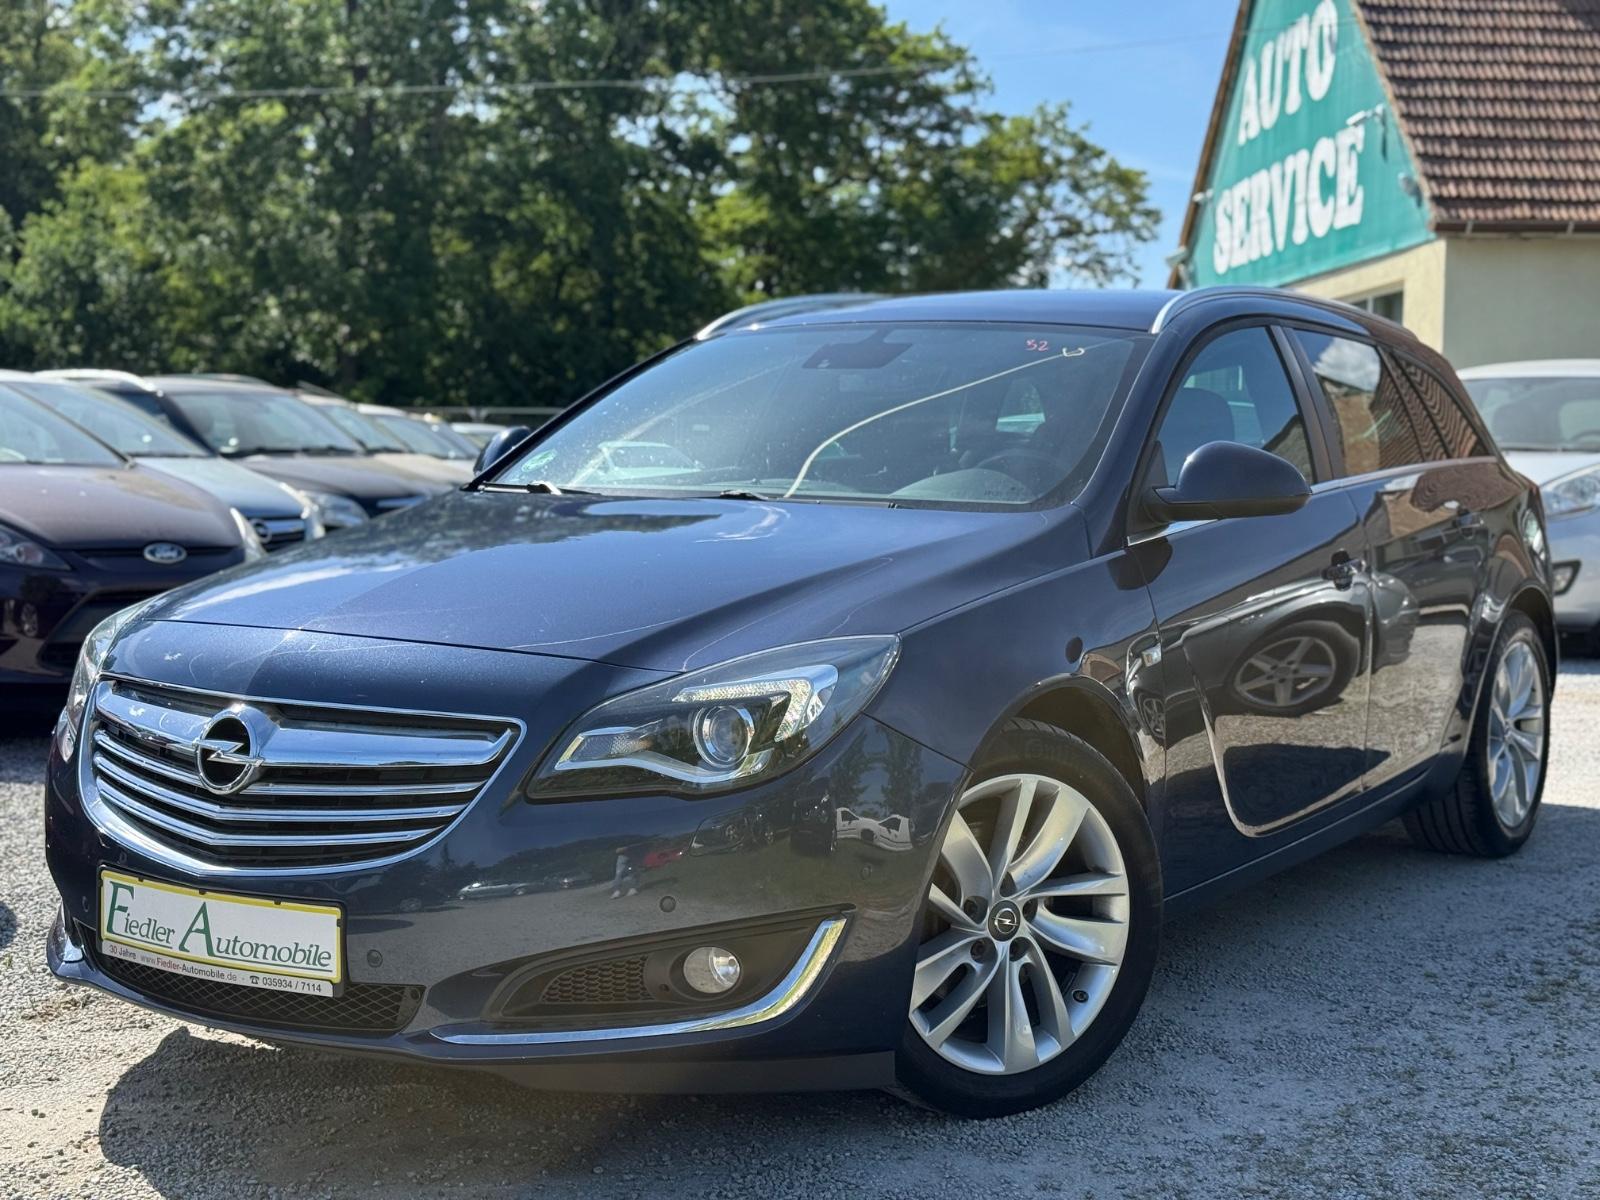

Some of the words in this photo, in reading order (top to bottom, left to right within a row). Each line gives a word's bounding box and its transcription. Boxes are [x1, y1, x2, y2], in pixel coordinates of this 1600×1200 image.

[1238, 0, 1338, 146] AUTO
[1213, 124, 1365, 275] SERVICE
[106, 880, 176, 944] Fiedler
[178, 902, 332, 968] Automobile
[109, 944, 117, 955] 30
[119, 948, 137, 960] Jahre
[140, 956, 237, 981] www.Fiedler-Automobile.de
[262, 976, 293, 989] 035934
[301, 982, 322, 993] 7114
